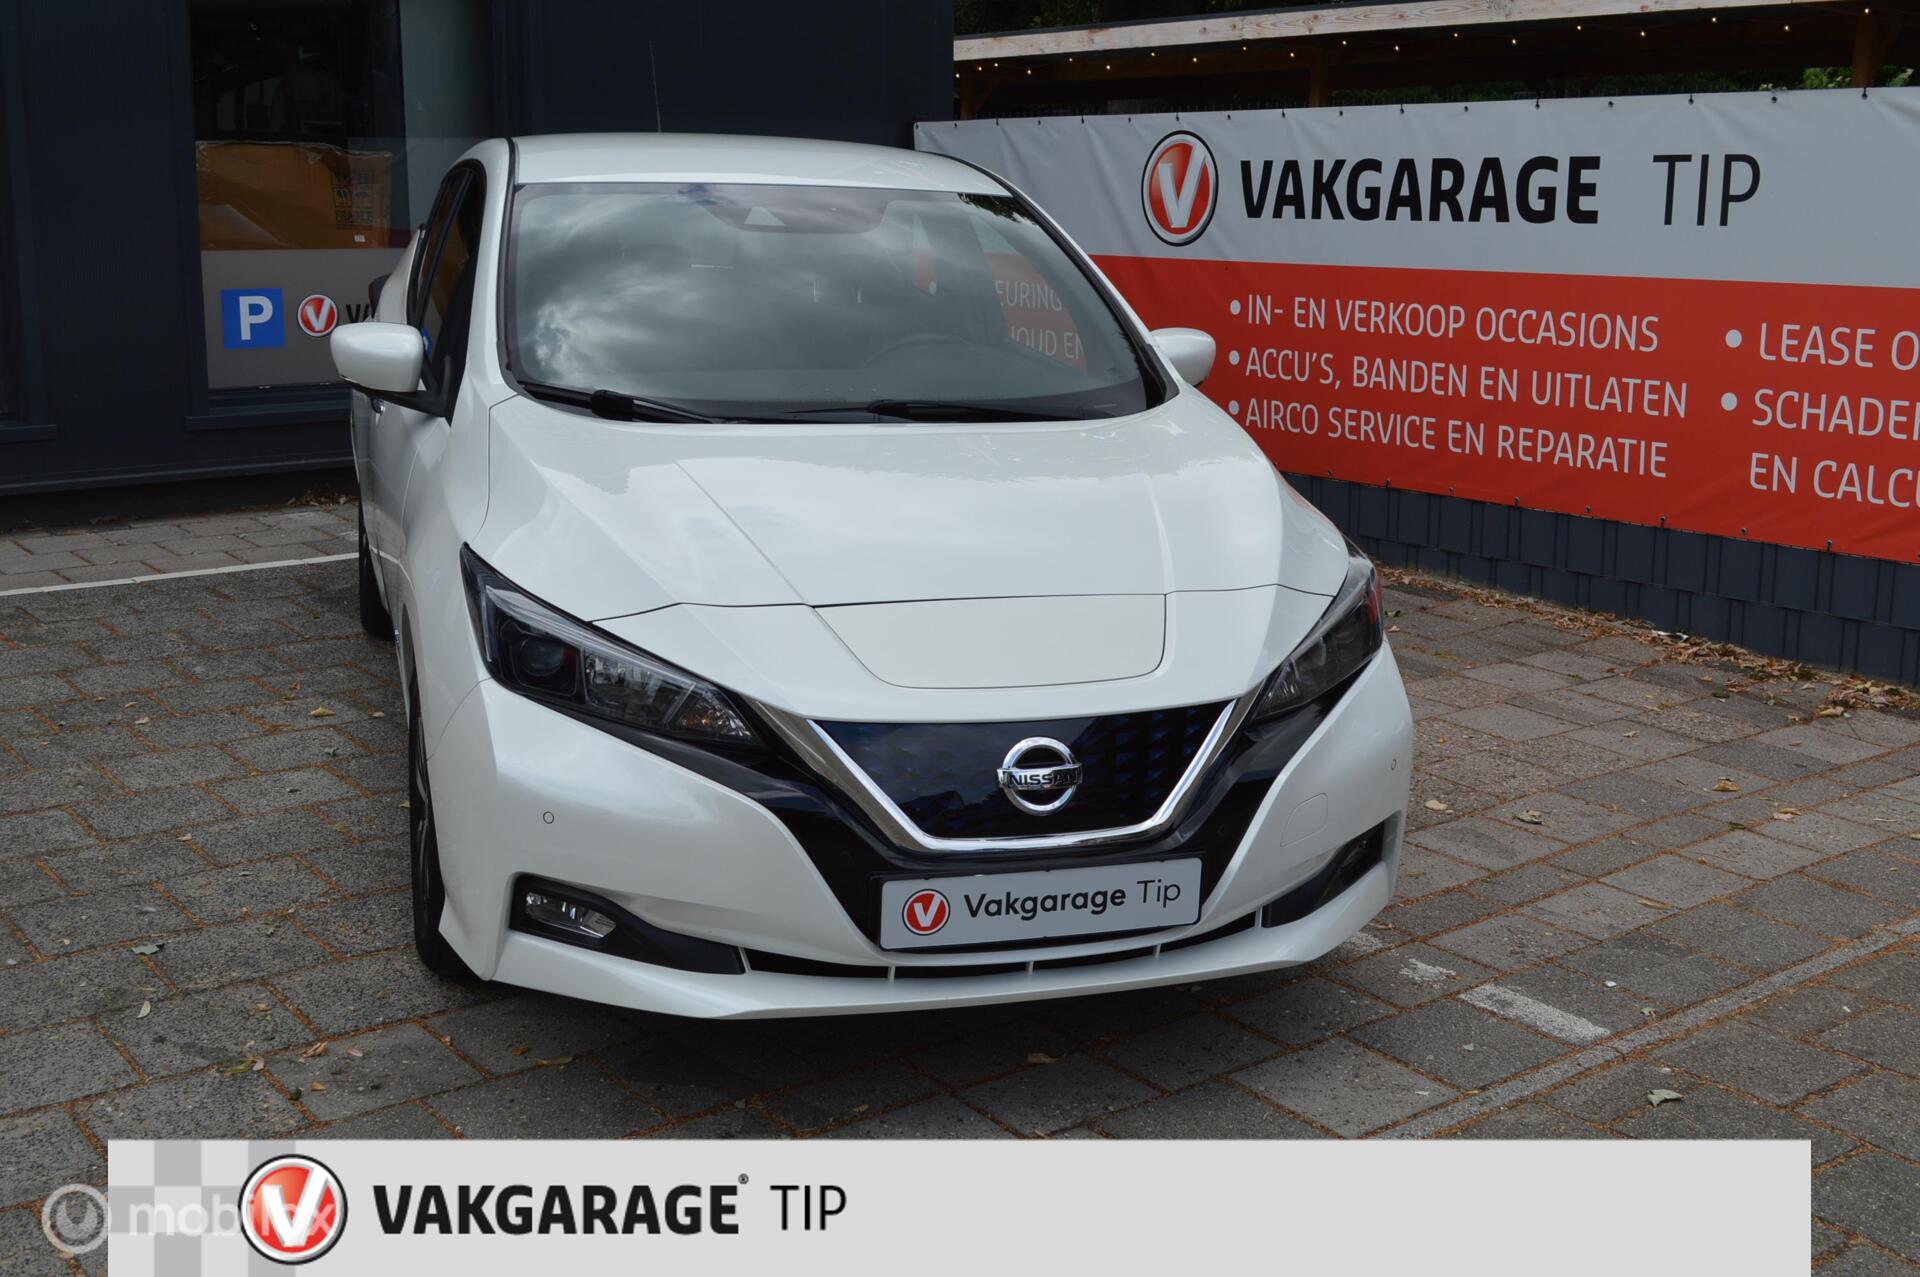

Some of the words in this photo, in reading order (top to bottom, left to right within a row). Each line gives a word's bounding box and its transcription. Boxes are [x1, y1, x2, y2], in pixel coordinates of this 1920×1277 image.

[1240, 155, 1600, 224] VAKGARAGE
[1652, 153, 1761, 226] TIP
[238, 295, 274, 341] P
[1247, 294, 1284, 326] IN-
[1293, 296, 1326, 330] EN
[1335, 299, 1466, 339] VERKOOP
[1475, 306, 1659, 353] OCCASIONS
[1758, 322, 1876, 368] LEASE
[1245, 346, 1341, 390] ACCU'S,
[1352, 355, 1468, 398] BANDEN
[1480, 366, 1518, 403] EN
[1531, 370, 1688, 419] UITLATEN
[1245, 397, 1319, 435] AIRCO
[1327, 406, 1436, 450] SERVICE
[1447, 419, 1485, 456] EN
[1497, 424, 1668, 478] REPARATIE
[1751, 388, 1920, 441] SCHADE
[1750, 452, 1798, 494] EN
[1008, 769, 1078, 787] NISSAN
[963, 887, 1127, 921] Vakgarage
[1135, 878, 1182, 908] Tip
